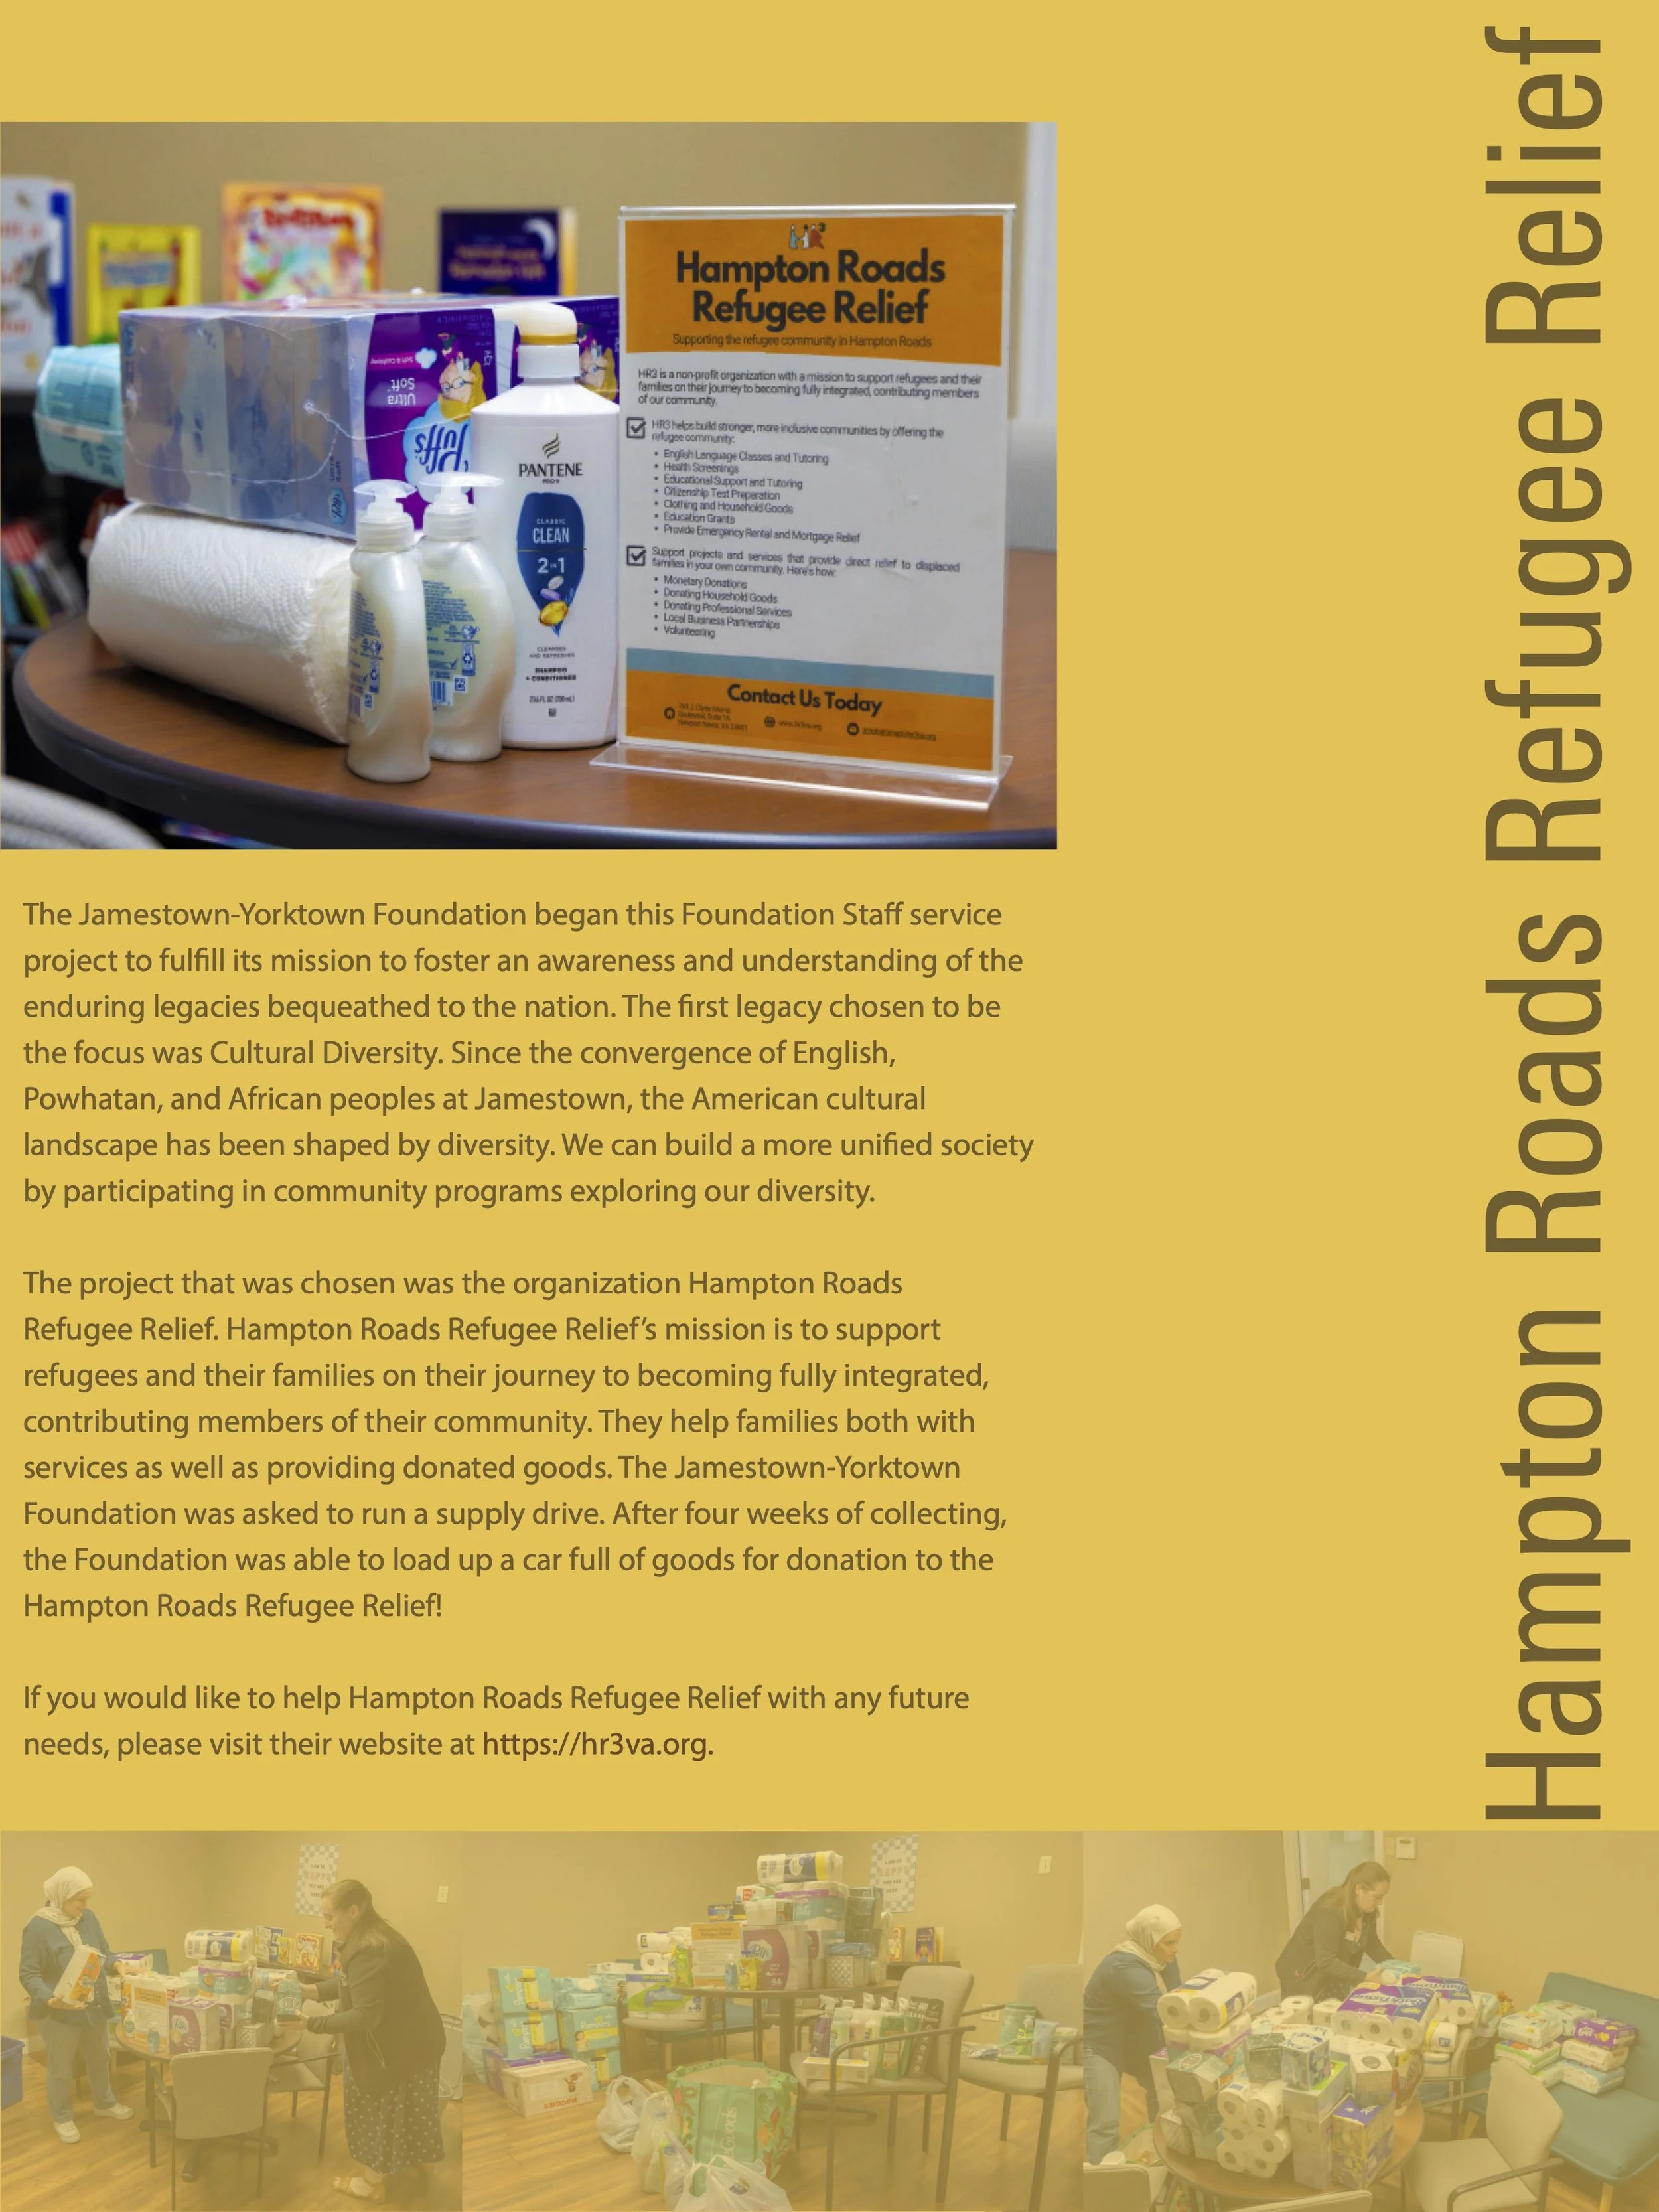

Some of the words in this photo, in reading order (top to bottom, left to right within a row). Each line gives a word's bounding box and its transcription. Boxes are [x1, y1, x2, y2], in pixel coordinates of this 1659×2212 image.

[677, 250, 829, 292] Hampton
[838, 248, 946, 283] Roads
[693, 288, 826, 332] Refugee
[835, 288, 930, 324] Relief
[673, 334, 723, 347] Supporting
[727, 334, 741, 345] the
[743, 335, 779, 347] refugee
[781, 335, 836, 348] community
[839, 336, 847, 346] in
[850, 336, 896, 348] Hampton
[899, 336, 931, 347] Roads
[638, 368, 657, 379] HR3
[660, 369, 666, 379] is
[676, 369, 719, 382] non-profit
[721, 370, 775, 382] organization
[778, 370, 796, 381] with
[807, 372, 844, 382] mission
[845, 373, 855, 382] to
[857, 373, 894, 384] support
[897, 373, 938, 386] refugees
[940, 374, 958, 384] and
[961, 373, 982, 385] their
[638, 382, 673, 392] families
[688, 382, 708, 392] their
[709, 383, 741, 395] journey
[743, 384, 753, 394] to
[755, 383, 800, 396] becoming
[802, 384, 820, 397] fully
[824, 384, 871, 398] integrated,
[873, 386, 930, 400] contributing
[932, 387, 979, 398] members
[387, 394, 416, 406] Ultra
[638, 394, 648, 404] of
[649, 396, 664, 405] our
[666, 395, 717, 407] community.
[652, 420, 670, 429] HR3
[672, 420, 695, 431] helps
[697, 420, 716, 431] build
[718, 421, 754, 434] stronger,
[781, 423, 818, 433] inclusive
[820, 425, 877, 436] communities
[880, 426, 890, 438] by
[893, 426, 927, 440] offering
[929, 427, 943, 437] the
[652, 431, 684, 443] refugee
[685, 432, 735, 444] community:
[415, 424, 469, 474] Puffs
[664, 449, 693, 461] English
[695, 451, 737, 463] Language
[739, 451, 772, 461] Classes
[775, 452, 790, 462] and
[793, 453, 828, 465] Tutoring
[518, 462, 583, 477] PANTENE
[664, 462, 691, 471] Health
[693, 464, 739, 475] Screenings
[664, 475, 712, 485] Educational
[714, 477, 747, 489] Support
[749, 479, 765, 487] and
[768, 479, 803, 490] Tutoring
[664, 500, 697, 511] Clothing
[700, 501, 715, 510] and
[718, 502, 762, 512] Household
[765, 504, 793, 514] Goods
[664, 512, 705, 523] Education
[707, 514, 735, 524] Grants
[532, 528, 569, 544] CLEAN
[664, 575, 703, 588] Monetary
[705, 577, 747, 589] Donations
[664, 613, 685, 624] Local
[688, 615, 724, 626] Business
[727, 617, 780, 630] Partnerships
[664, 625, 715, 639] Volunteering
[727, 684, 795, 705] Contact
[799, 690, 820, 708] Us
[824, 691, 883, 717] Today
[751, 1943, 770, 1959] Puffs
[174, 2019, 188, 2031] Puffs
[581, 2021, 611, 2030] Pampers
[543, 2097, 578, 2110] HUGGIES
